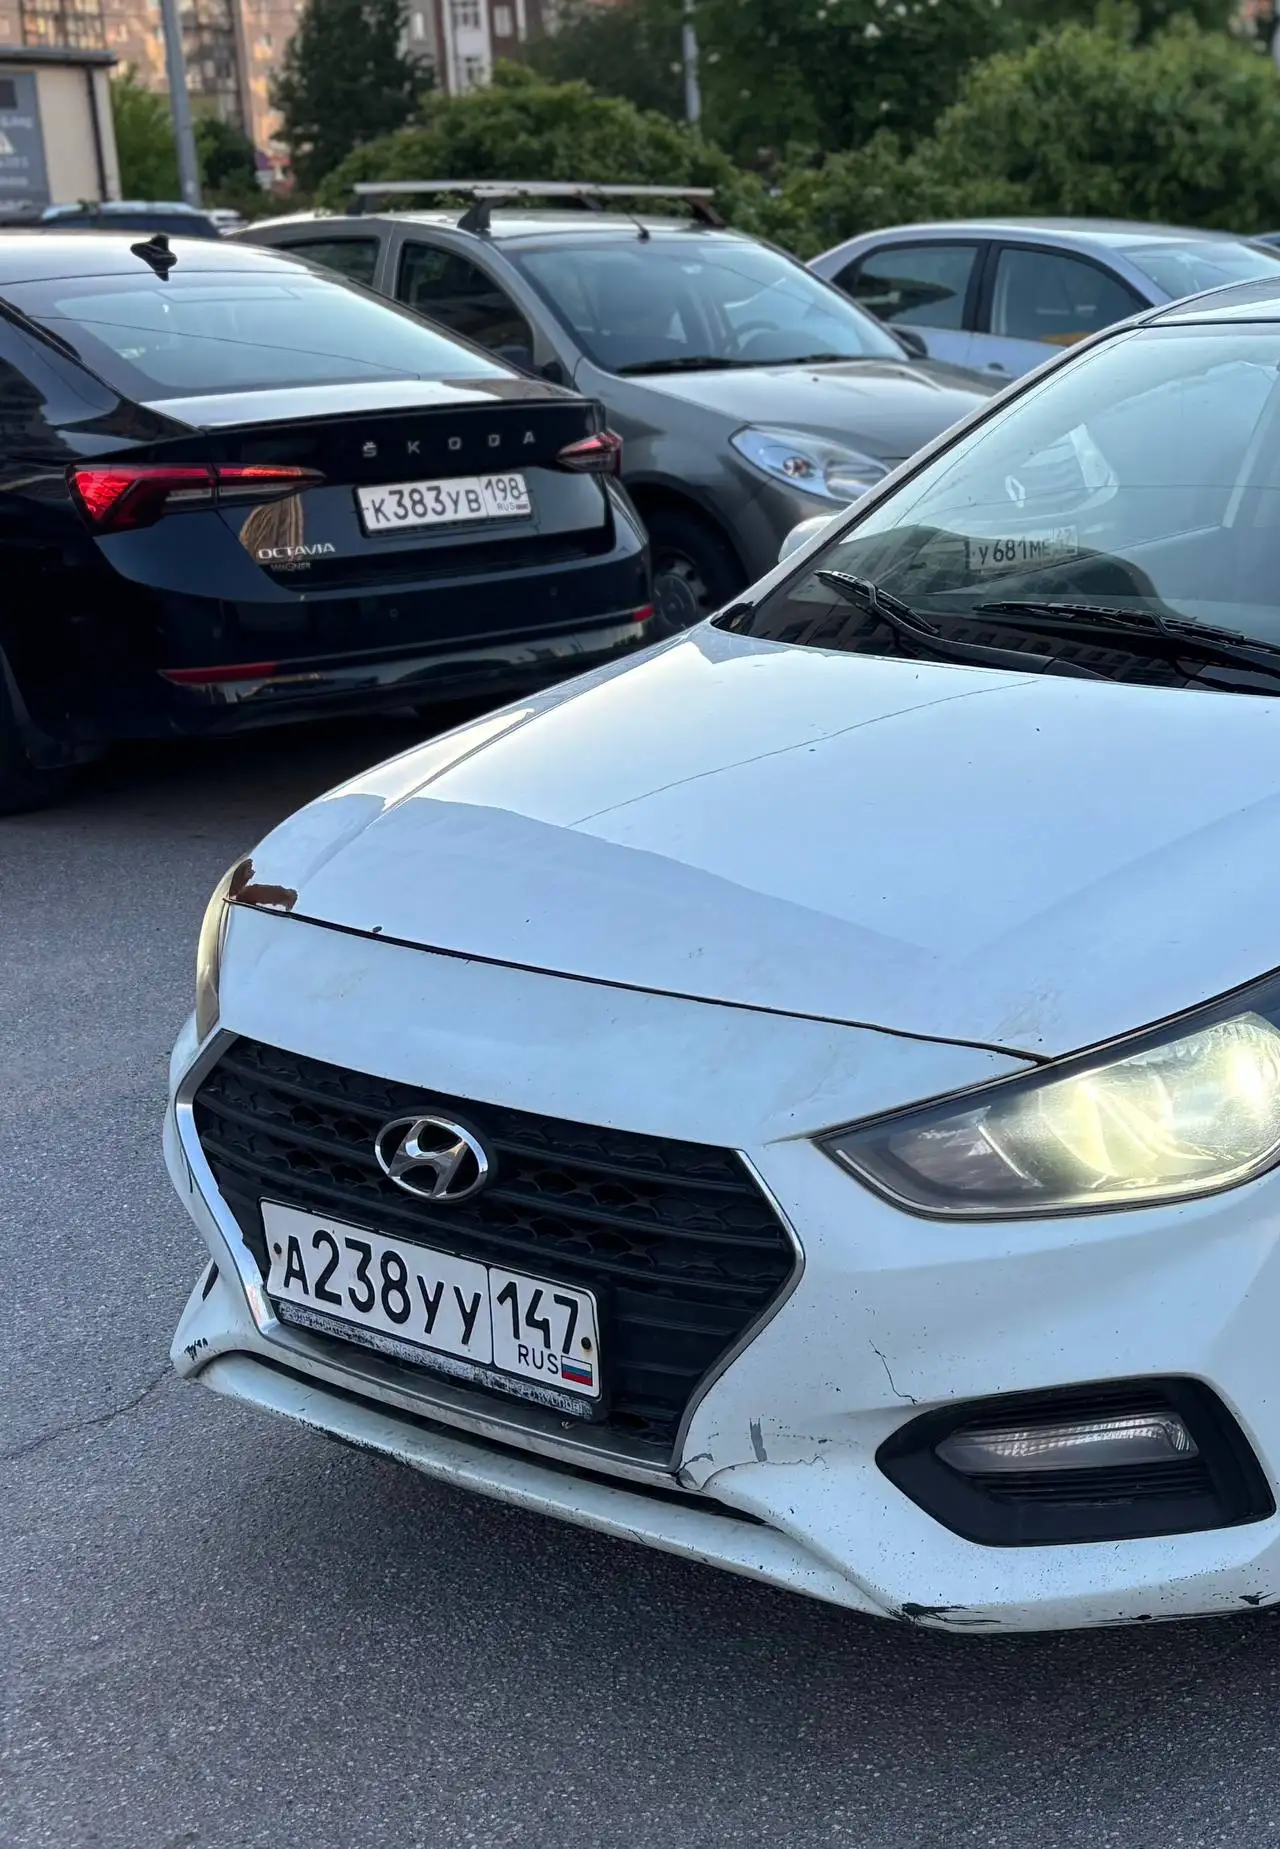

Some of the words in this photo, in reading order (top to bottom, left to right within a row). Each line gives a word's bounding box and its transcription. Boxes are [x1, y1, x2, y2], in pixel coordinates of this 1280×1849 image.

[484, 477, 522, 502] 198
[497, 502, 516, 512] RUS
[258, 542, 336, 559] OCTAVIA
[496, 1280, 580, 1355] 147
[517, 1343, 559, 1375] RUS
